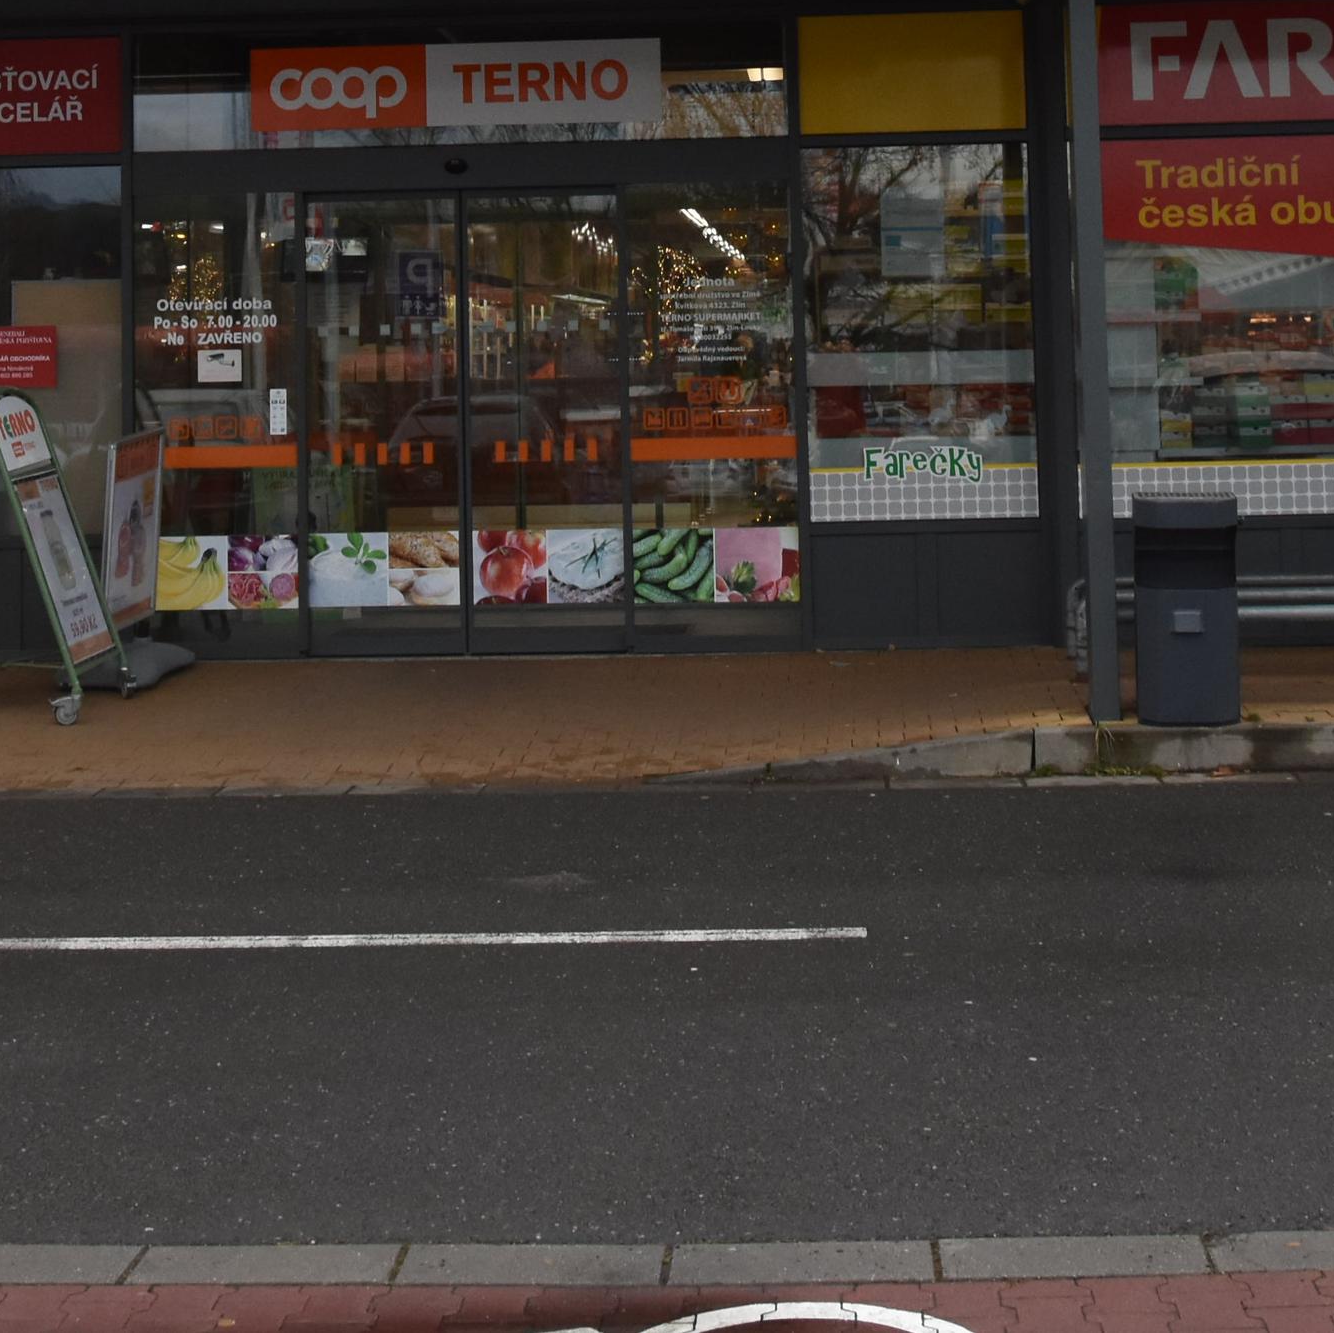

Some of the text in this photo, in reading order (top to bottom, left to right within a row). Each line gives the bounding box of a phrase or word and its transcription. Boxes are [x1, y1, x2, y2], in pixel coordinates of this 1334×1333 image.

[269, 59, 629, 119] coop TERNO
[1135, 154, 1301, 189] Tradiční
[1138, 194, 1258, 229] česká
[156, 296, 272, 312] Otevírací doba
[154, 316, 170, 329] Po
[180, 315, 199, 329] So
[242, 314, 278, 328] 20.00
[660, 311, 762, 323] TERNO SUPERMARKET
[197, 330, 263, 346] ZAVŘENO
